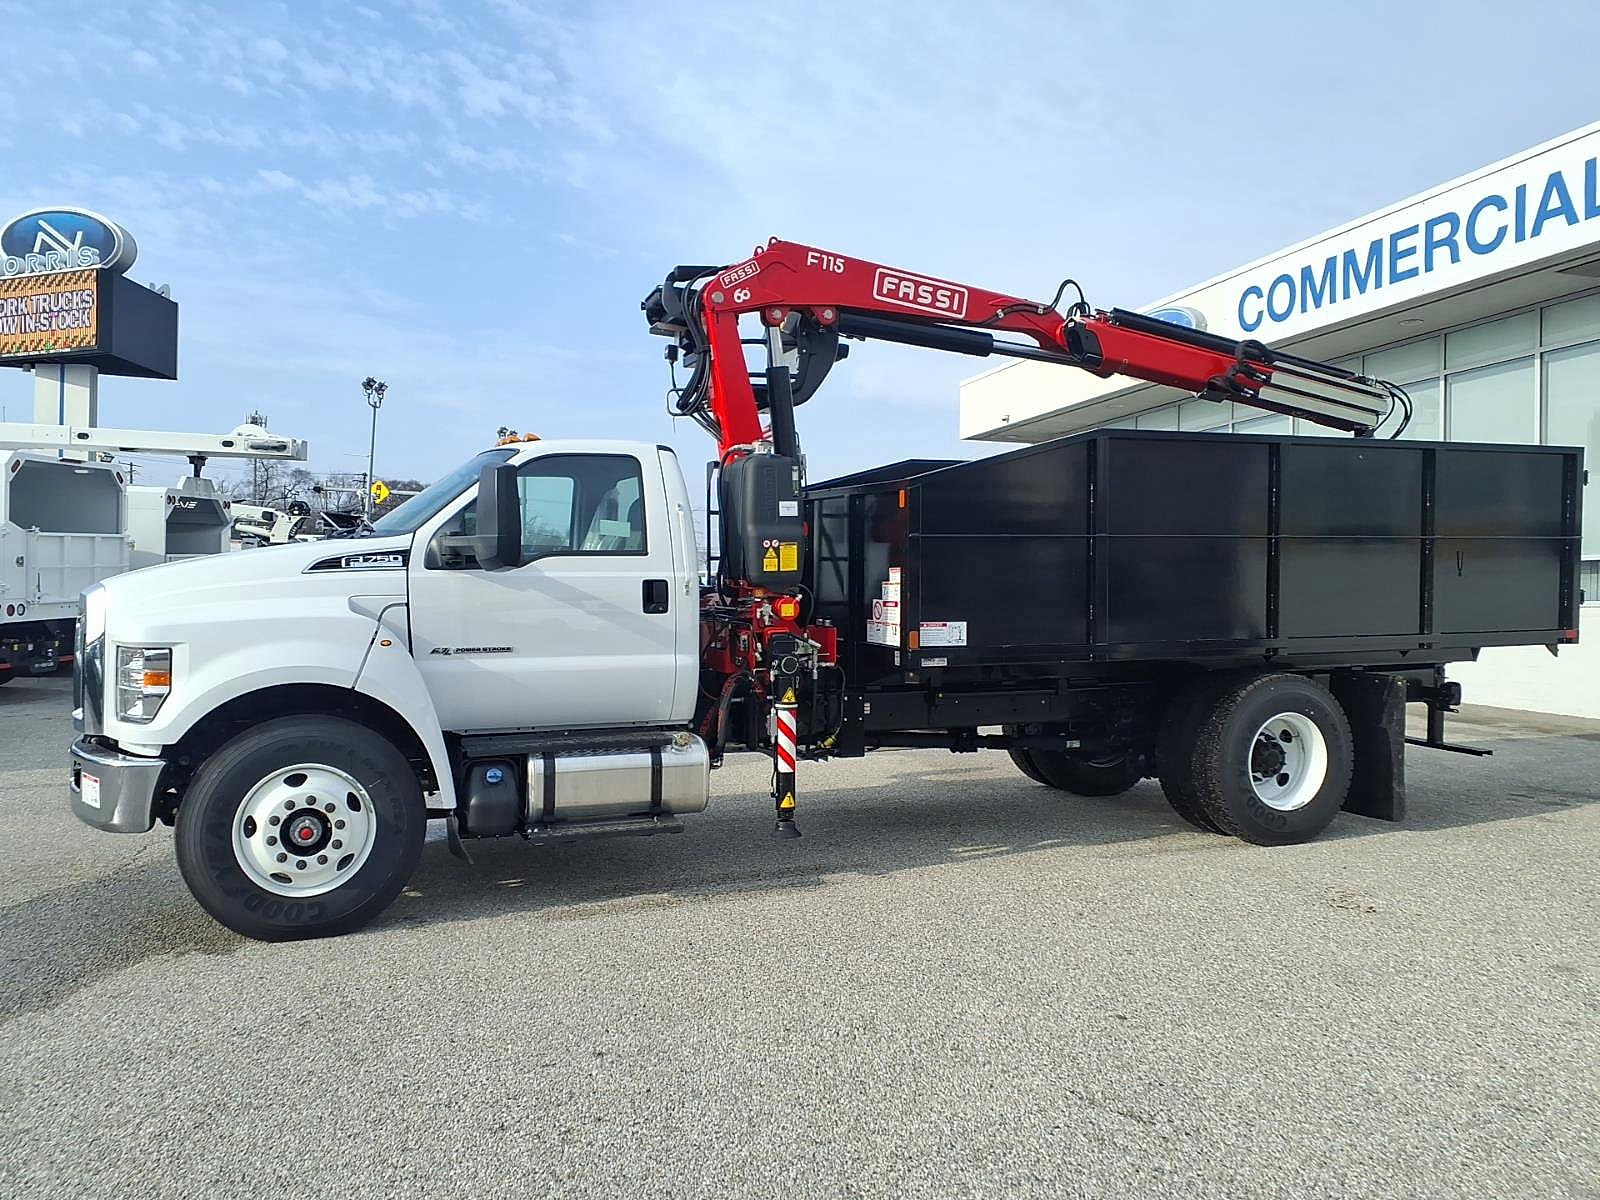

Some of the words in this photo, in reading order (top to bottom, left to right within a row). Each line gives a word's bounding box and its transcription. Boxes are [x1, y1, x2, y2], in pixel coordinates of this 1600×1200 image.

[1238, 157, 1600, 332] COMMERCIAL
[723, 263, 757, 285] FASSI
[806, 251, 845, 274] F115
[30, 289, 94, 315] TRUCKS
[881, 277, 960, 311] FASSI
